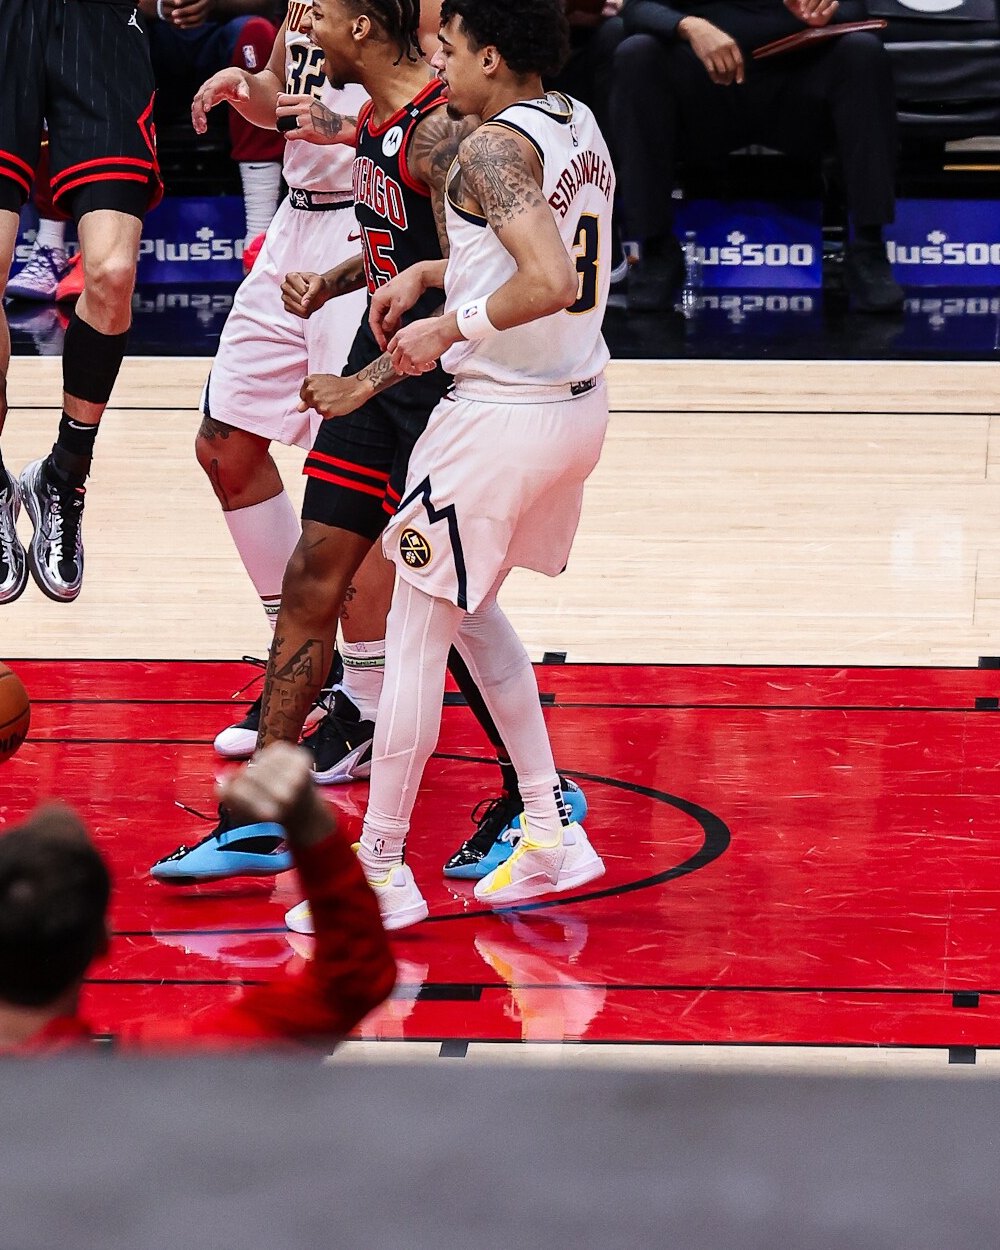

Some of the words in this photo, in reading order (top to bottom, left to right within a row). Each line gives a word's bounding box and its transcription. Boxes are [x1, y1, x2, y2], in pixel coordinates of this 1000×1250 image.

[286, 42, 326, 100] 32
[137, 239, 246, 261] Plus5
[360, 226, 400, 297] 5
[565, 212, 600, 316] 3
[697, 243, 813, 266] us500
[886, 240, 1000, 266] lus500
